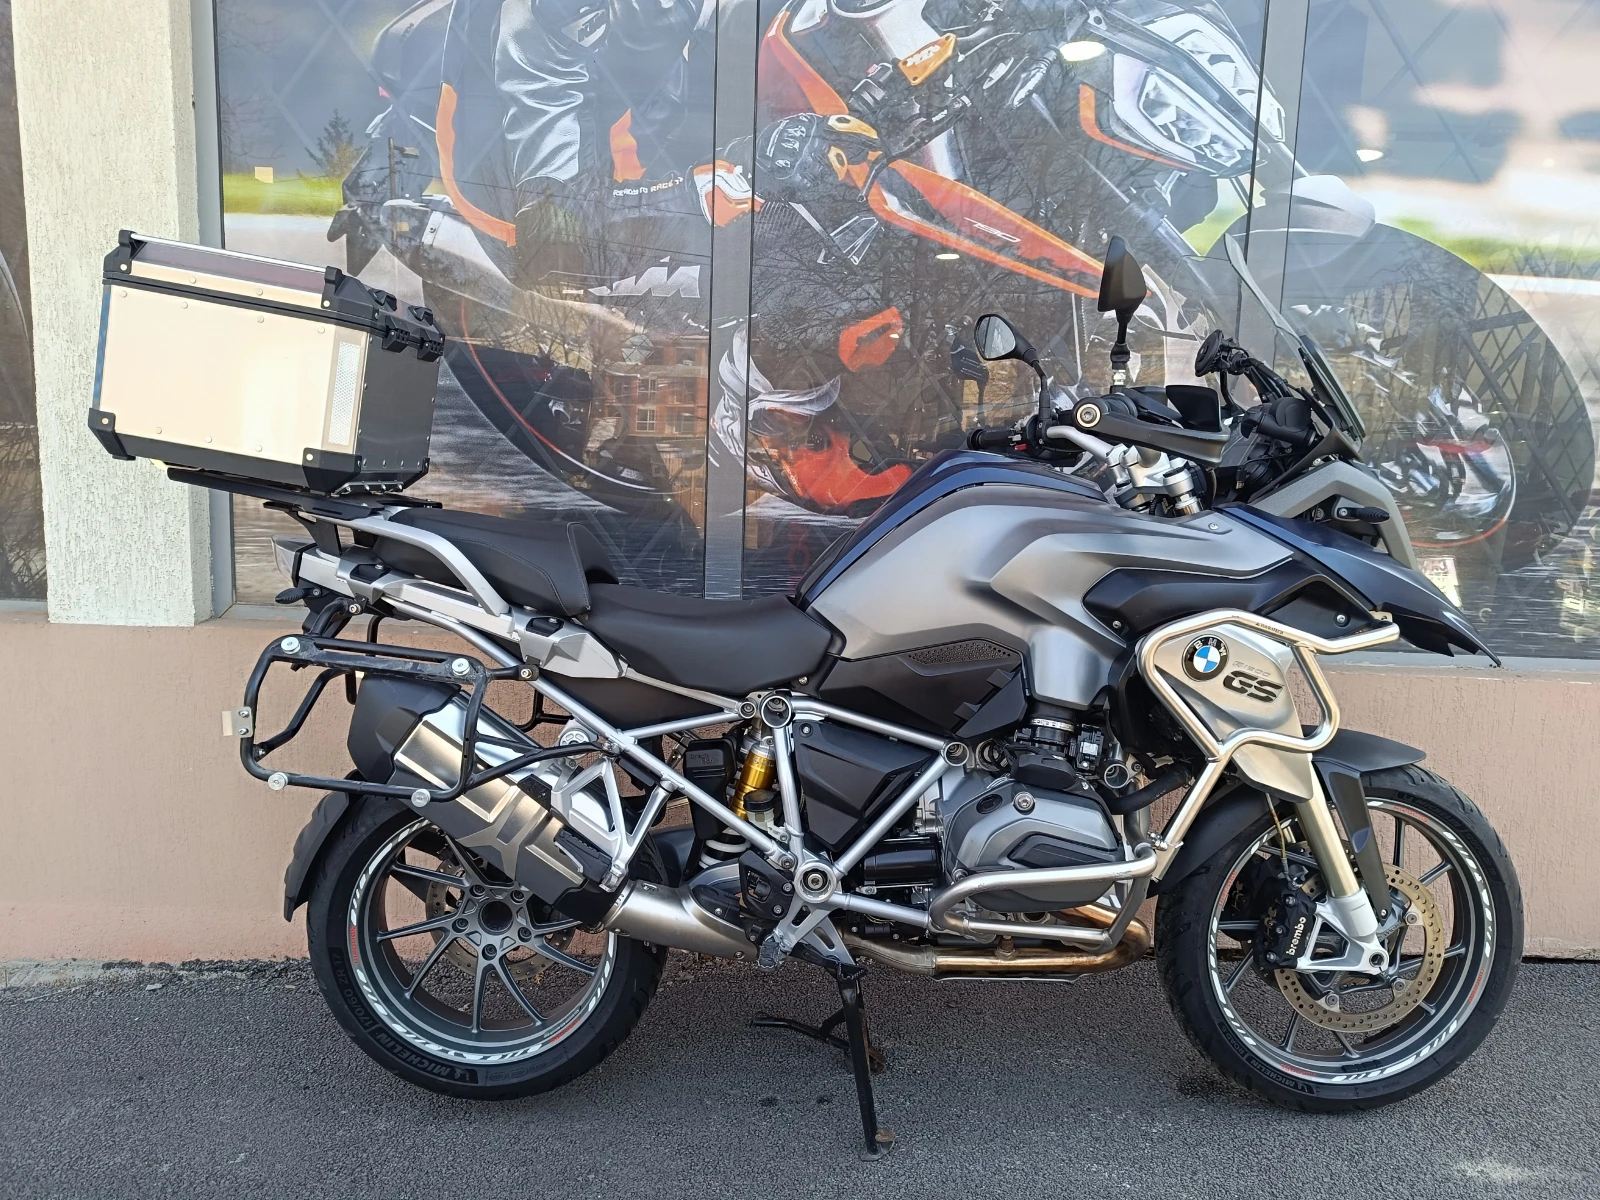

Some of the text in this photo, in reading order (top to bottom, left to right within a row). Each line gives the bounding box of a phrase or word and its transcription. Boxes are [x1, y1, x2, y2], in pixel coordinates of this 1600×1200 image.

[1222, 670, 1285, 703] GS
[1286, 916, 1306, 956] brembo
[337, 968, 350, 985] ZR
[344, 990, 373, 1028] 170/60
[375, 1031, 452, 1078] MICHELIN
[1225, 1033, 1246, 1055] ROAD
[1250, 1058, 1298, 1090] MICHELIN
